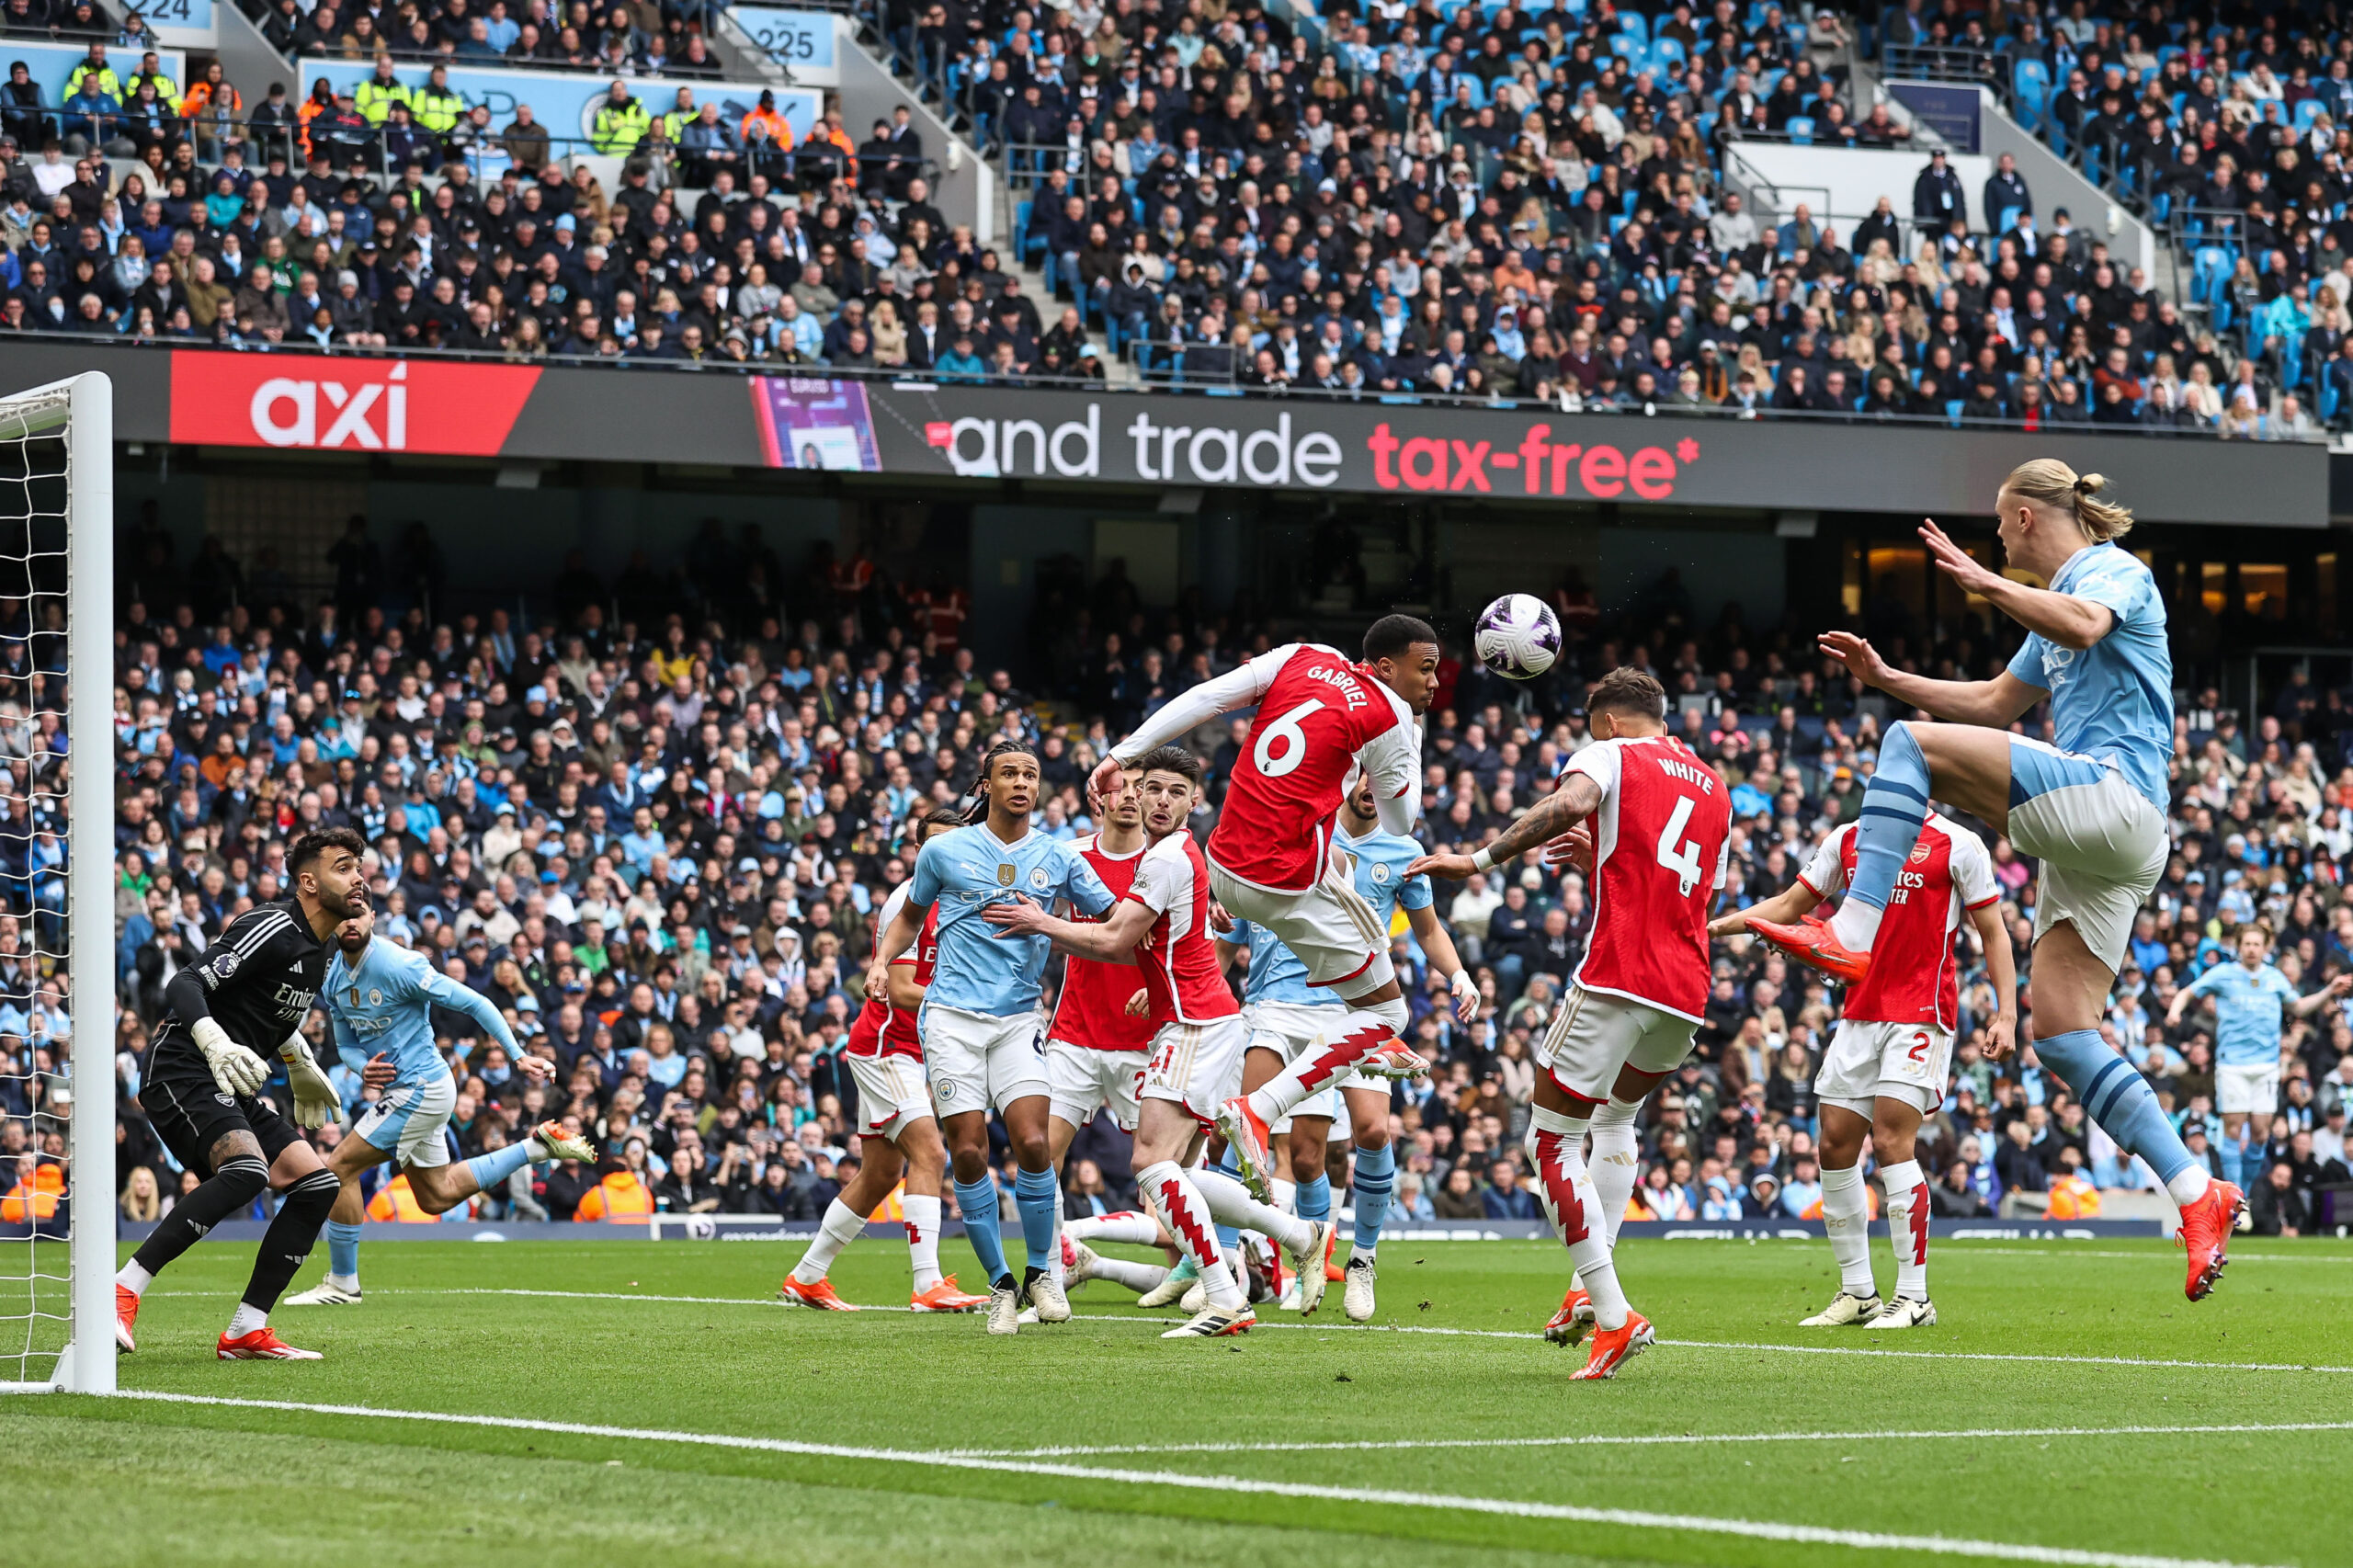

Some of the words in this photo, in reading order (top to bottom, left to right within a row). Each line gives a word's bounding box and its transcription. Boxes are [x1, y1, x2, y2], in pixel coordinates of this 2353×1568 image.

[758, 28, 813, 59] 225
[251, 360, 407, 450] axi
[949, 403, 1100, 477] and
[1128, 412, 1343, 487] trade
[1307, 665, 1369, 712] GABRIEL
[1253, 698, 1327, 778] 6
[1657, 758, 1714, 796] WHITE
[1656, 794, 1703, 899] 4
[1148, 1045, 1176, 1074] 41
[1908, 1032, 1929, 1062] 2
[1827, 1219, 1847, 1228] FC
[1891, 1209, 1905, 1221] FC
